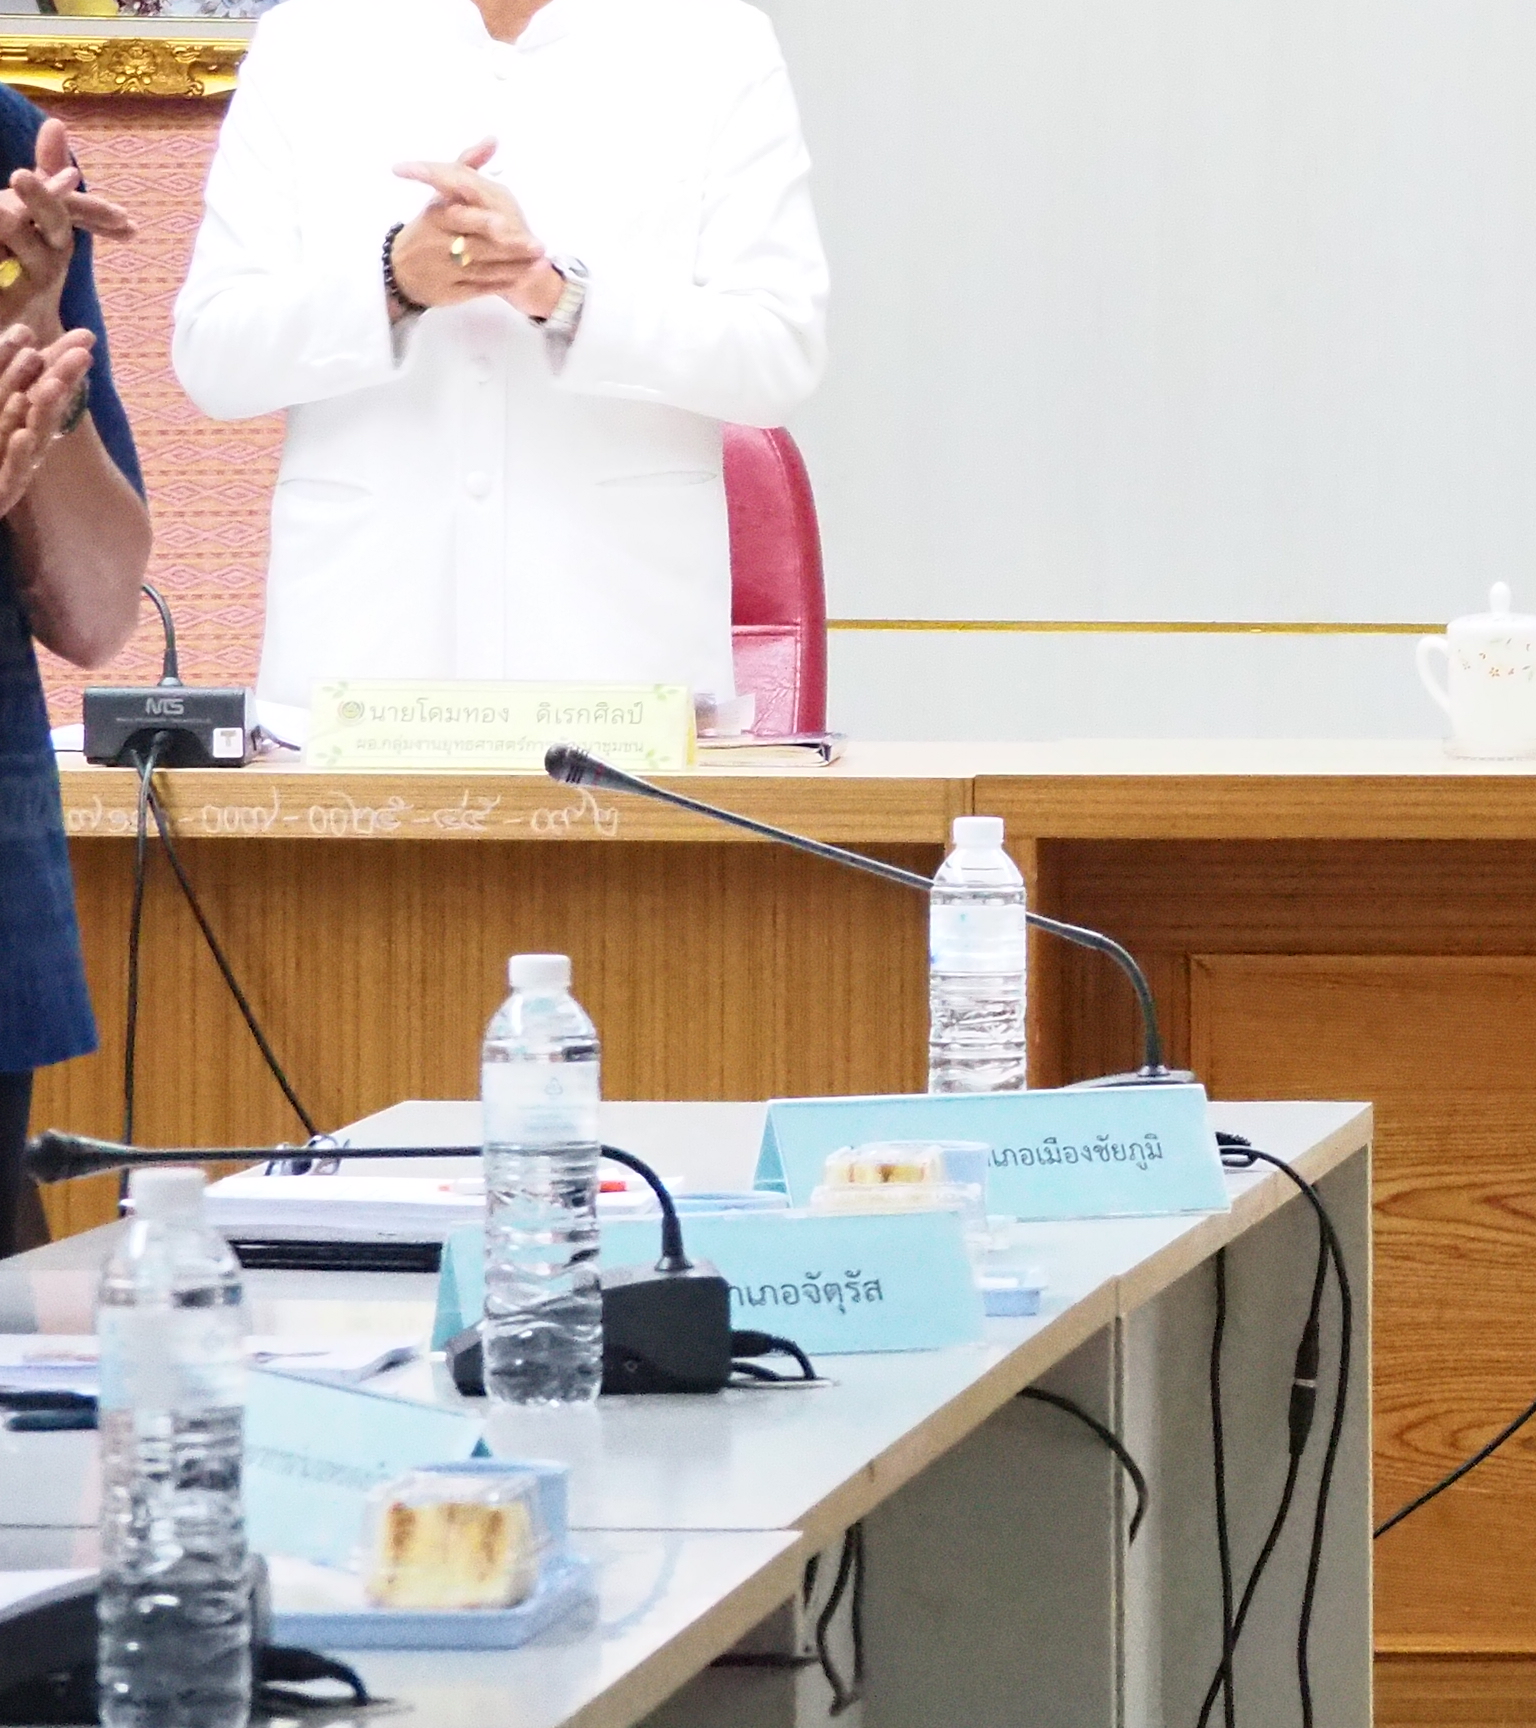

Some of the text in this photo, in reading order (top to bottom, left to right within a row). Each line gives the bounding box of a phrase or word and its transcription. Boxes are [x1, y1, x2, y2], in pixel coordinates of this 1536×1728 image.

[369, 697, 510, 724] นายโดมทอง
[988, 1132, 1164, 1171] เภอเมืองชัยภูมิ
